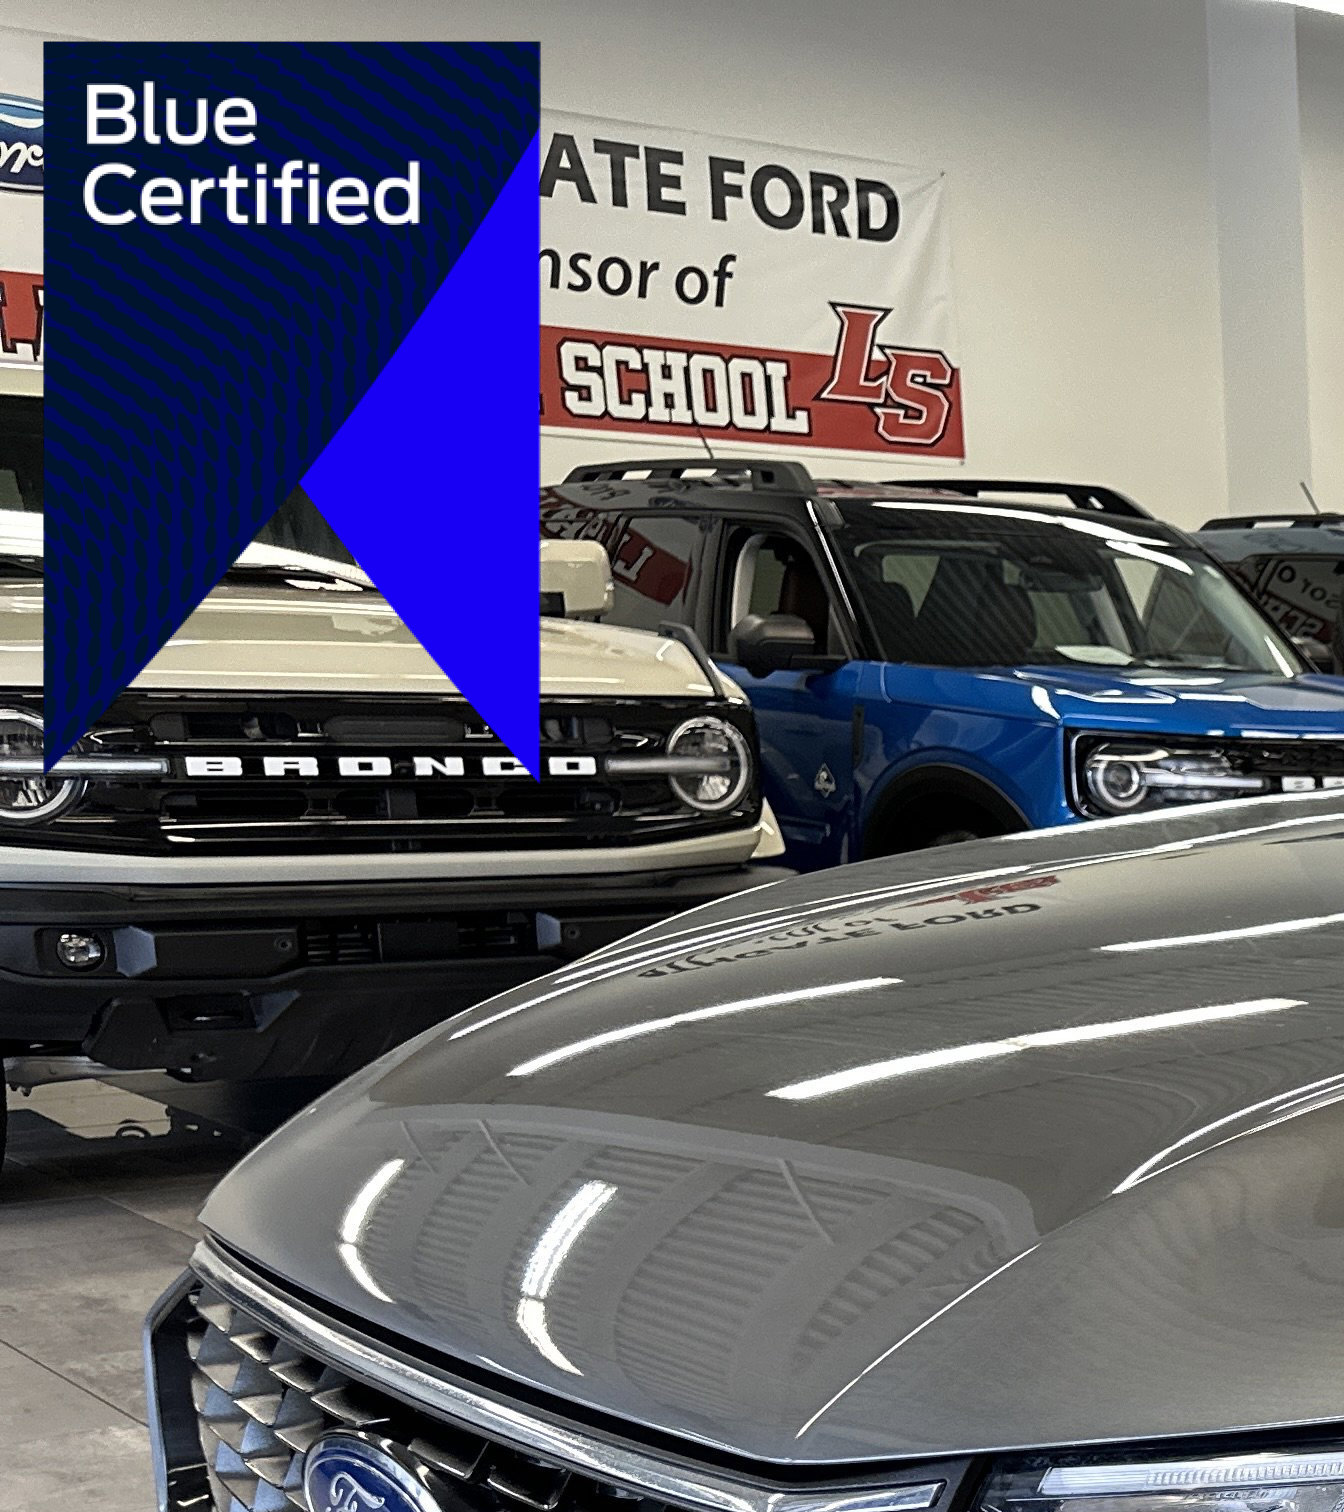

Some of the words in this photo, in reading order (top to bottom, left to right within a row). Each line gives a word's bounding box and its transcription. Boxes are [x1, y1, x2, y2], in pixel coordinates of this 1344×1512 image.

[708, 155, 901, 243] FORD
[674, 253, 737, 308] of
[558, 338, 811, 437] SCHOOL
[185, 756, 596, 776] BRONCO
